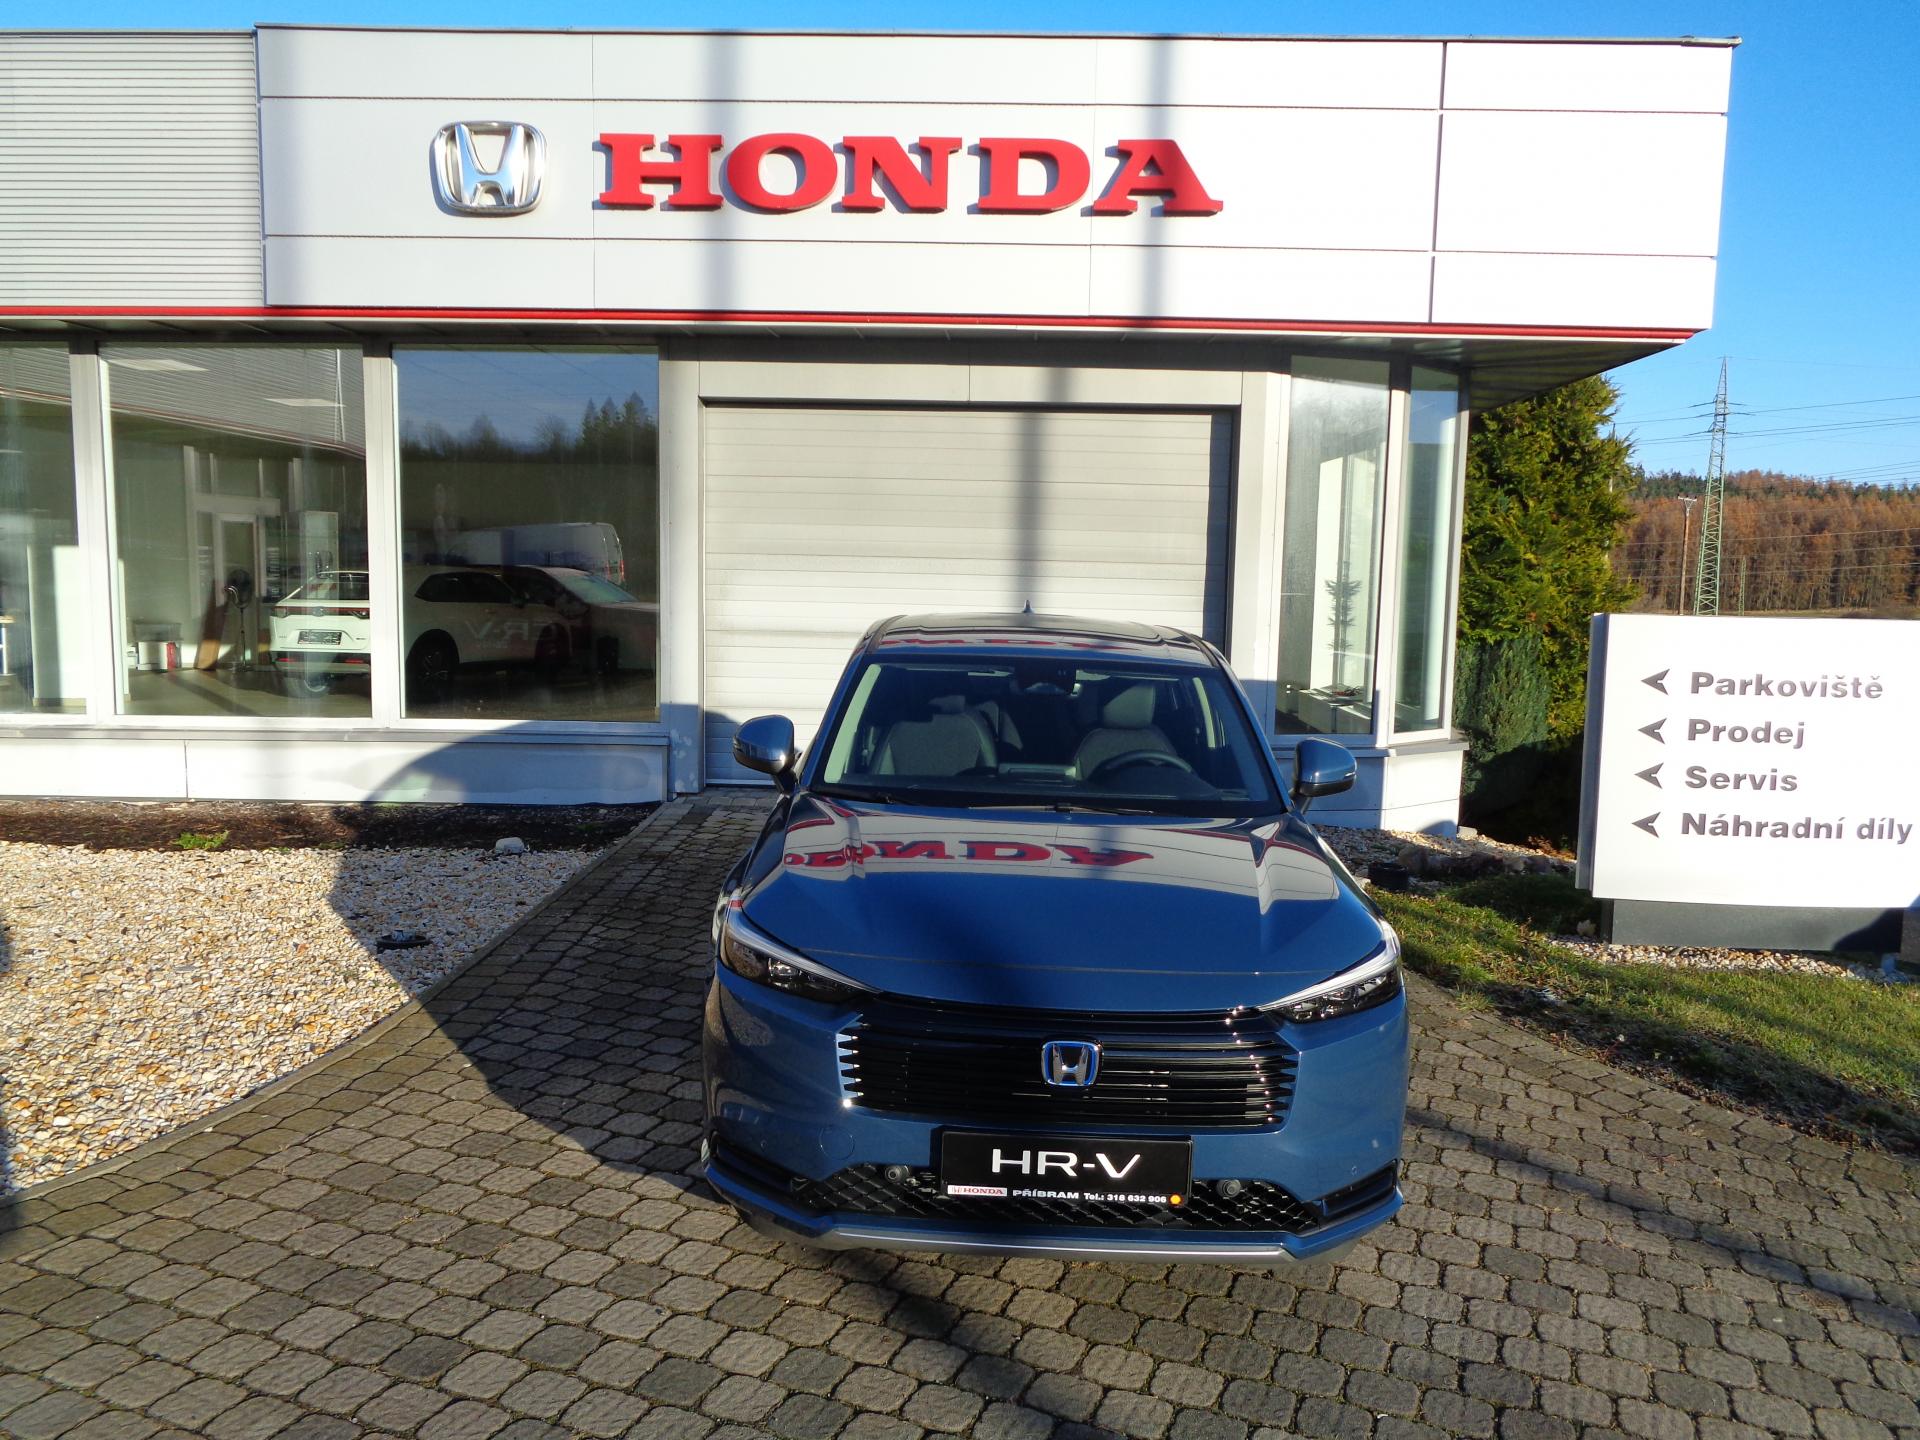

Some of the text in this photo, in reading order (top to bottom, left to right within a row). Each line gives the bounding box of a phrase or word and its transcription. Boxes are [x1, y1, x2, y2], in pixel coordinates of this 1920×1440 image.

[598, 132, 1224, 217] HONDA
[1690, 671, 1884, 699] Parkoviště
[1687, 718, 1805, 750] Prodej
[1684, 765, 1799, 792] Servis
[1681, 812, 1913, 845] Náhradní díly
[991, 1148, 1141, 1178] HR-V
[963, 1187, 1167, 1203] HONDA PŘÍBRAM Tel.: 318 632 906
